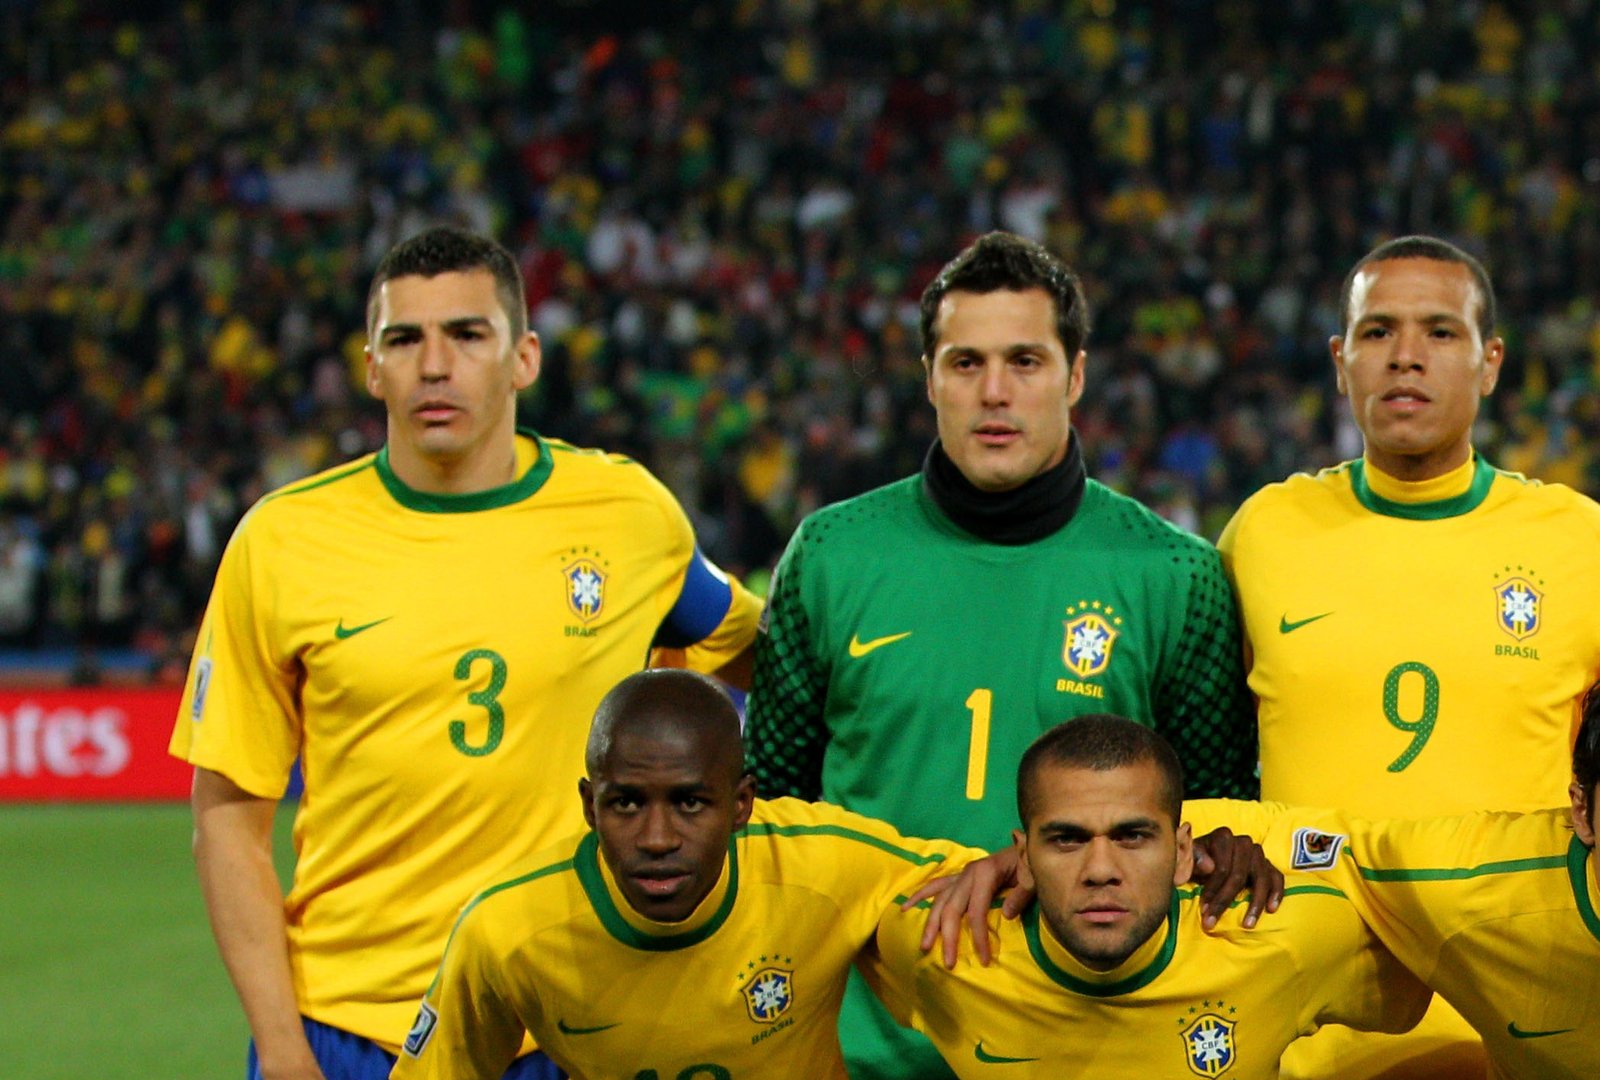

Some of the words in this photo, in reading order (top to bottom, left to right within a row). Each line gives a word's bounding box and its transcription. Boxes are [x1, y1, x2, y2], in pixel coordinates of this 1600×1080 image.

[1494, 644, 1541, 661] BRASIL
[1055, 678, 1105, 699] BRASIL
[448, 648, 508, 758] 3
[1382, 660, 1441, 774] 9
[964, 688, 993, 801] 1
[751, 1017, 796, 1045] BRASIL
[1201, 1039, 1220, 1050] CBF
